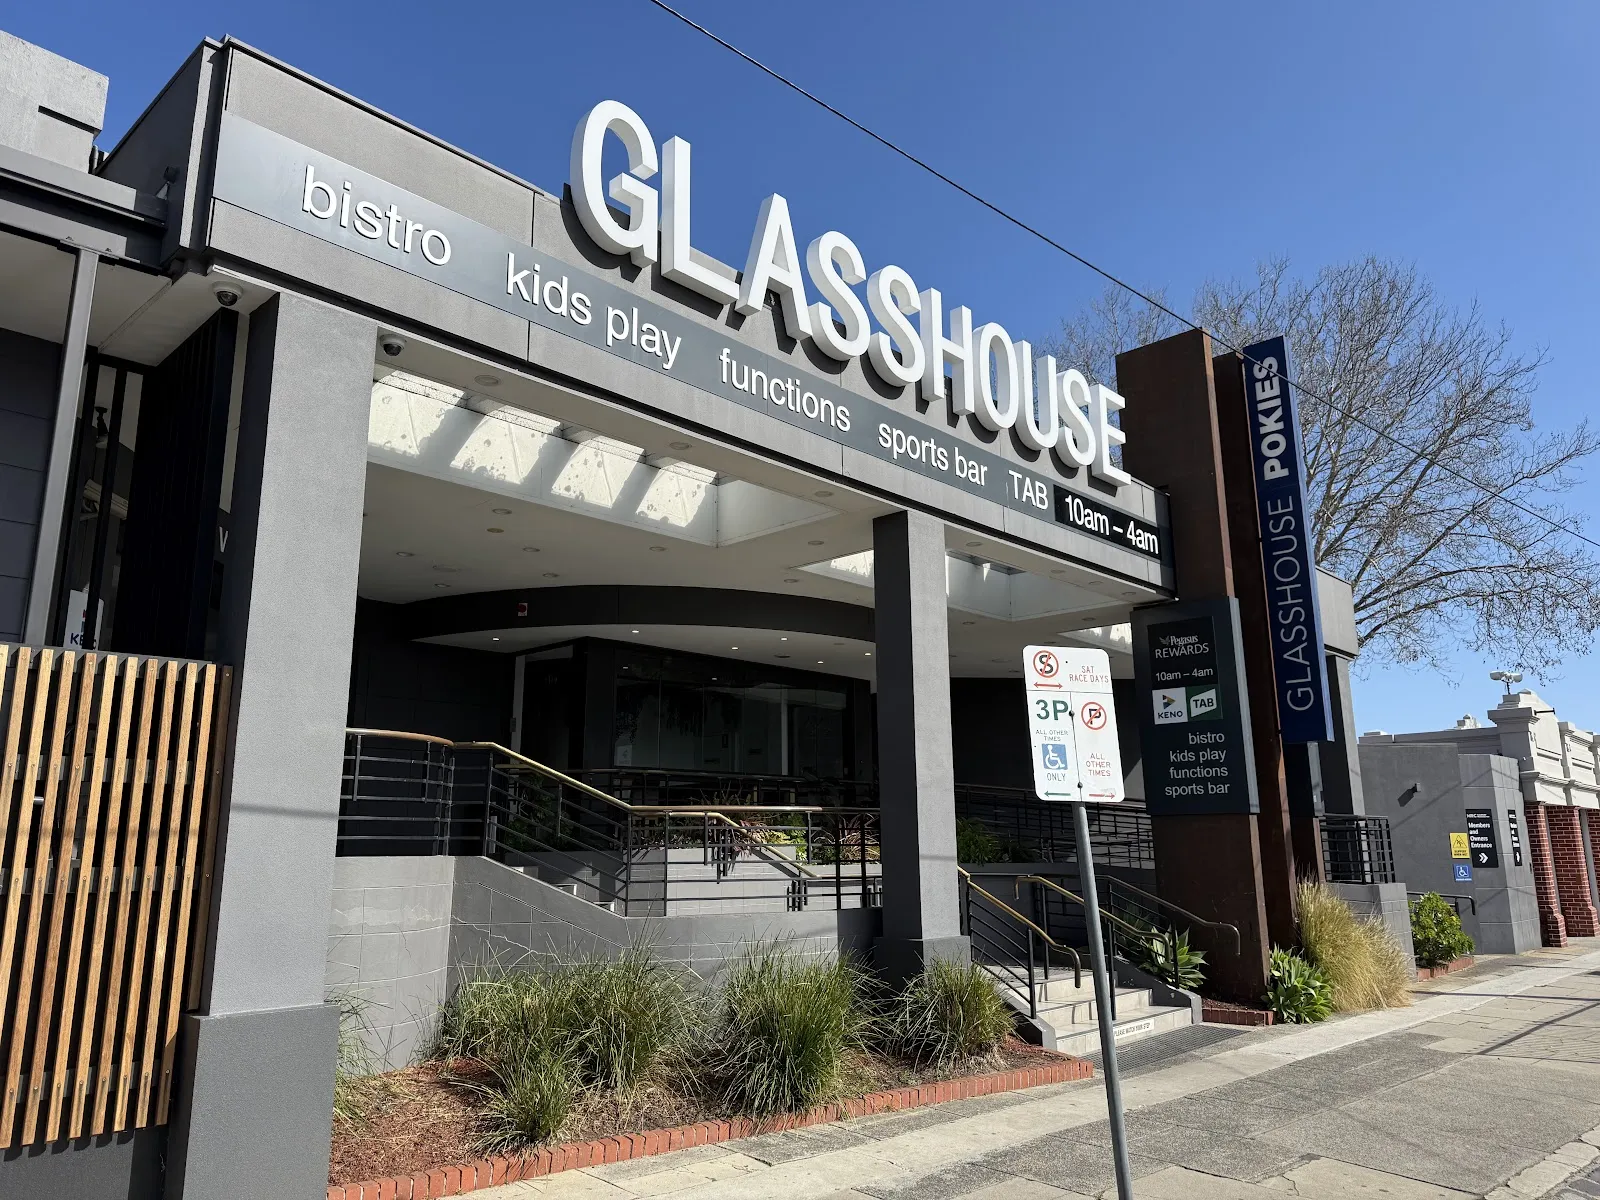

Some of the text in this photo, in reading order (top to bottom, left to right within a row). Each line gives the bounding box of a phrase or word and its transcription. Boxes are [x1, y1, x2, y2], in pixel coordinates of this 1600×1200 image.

[570, 100, 1131, 487] GLASSHOUSE
[301, 165, 452, 266] bistro
[506, 252, 592, 326] kids
[606, 305, 682, 370] play
[719, 348, 851, 432] functions
[878, 422, 949, 471] sports
[955, 447, 987, 486] bar
[1008, 470, 1049, 510] TAB
[1065, 495, 1110, 536] 10am
[1127, 528, 1158, 554] 4am
[1255, 356, 1289, 481] POKIES
[1268, 495, 1314, 711] GLASSHOUSE
[1169, 635, 1199, 647] Pegasus
[1155, 643, 1209, 658] REWARDS
[1081, 665, 1095, 674] SAT
[1156, 671, 1181, 681] 10am
[1192, 668, 1213, 678] 4am
[1069, 674, 1109, 683] RACE DAYS
[1193, 697, 1214, 709] TAB
[1035, 699, 1069, 721] 3P
[1157, 710, 1183, 719] KENO
[1188, 732, 1225, 745] bistro
[1169, 749, 1226, 763] kids play
[1047, 773, 1066, 781] ONLY
[1088, 769, 1111, 777] TIMES
[1169, 766, 1228, 779] functions
[1165, 782, 1230, 798] sports bar
